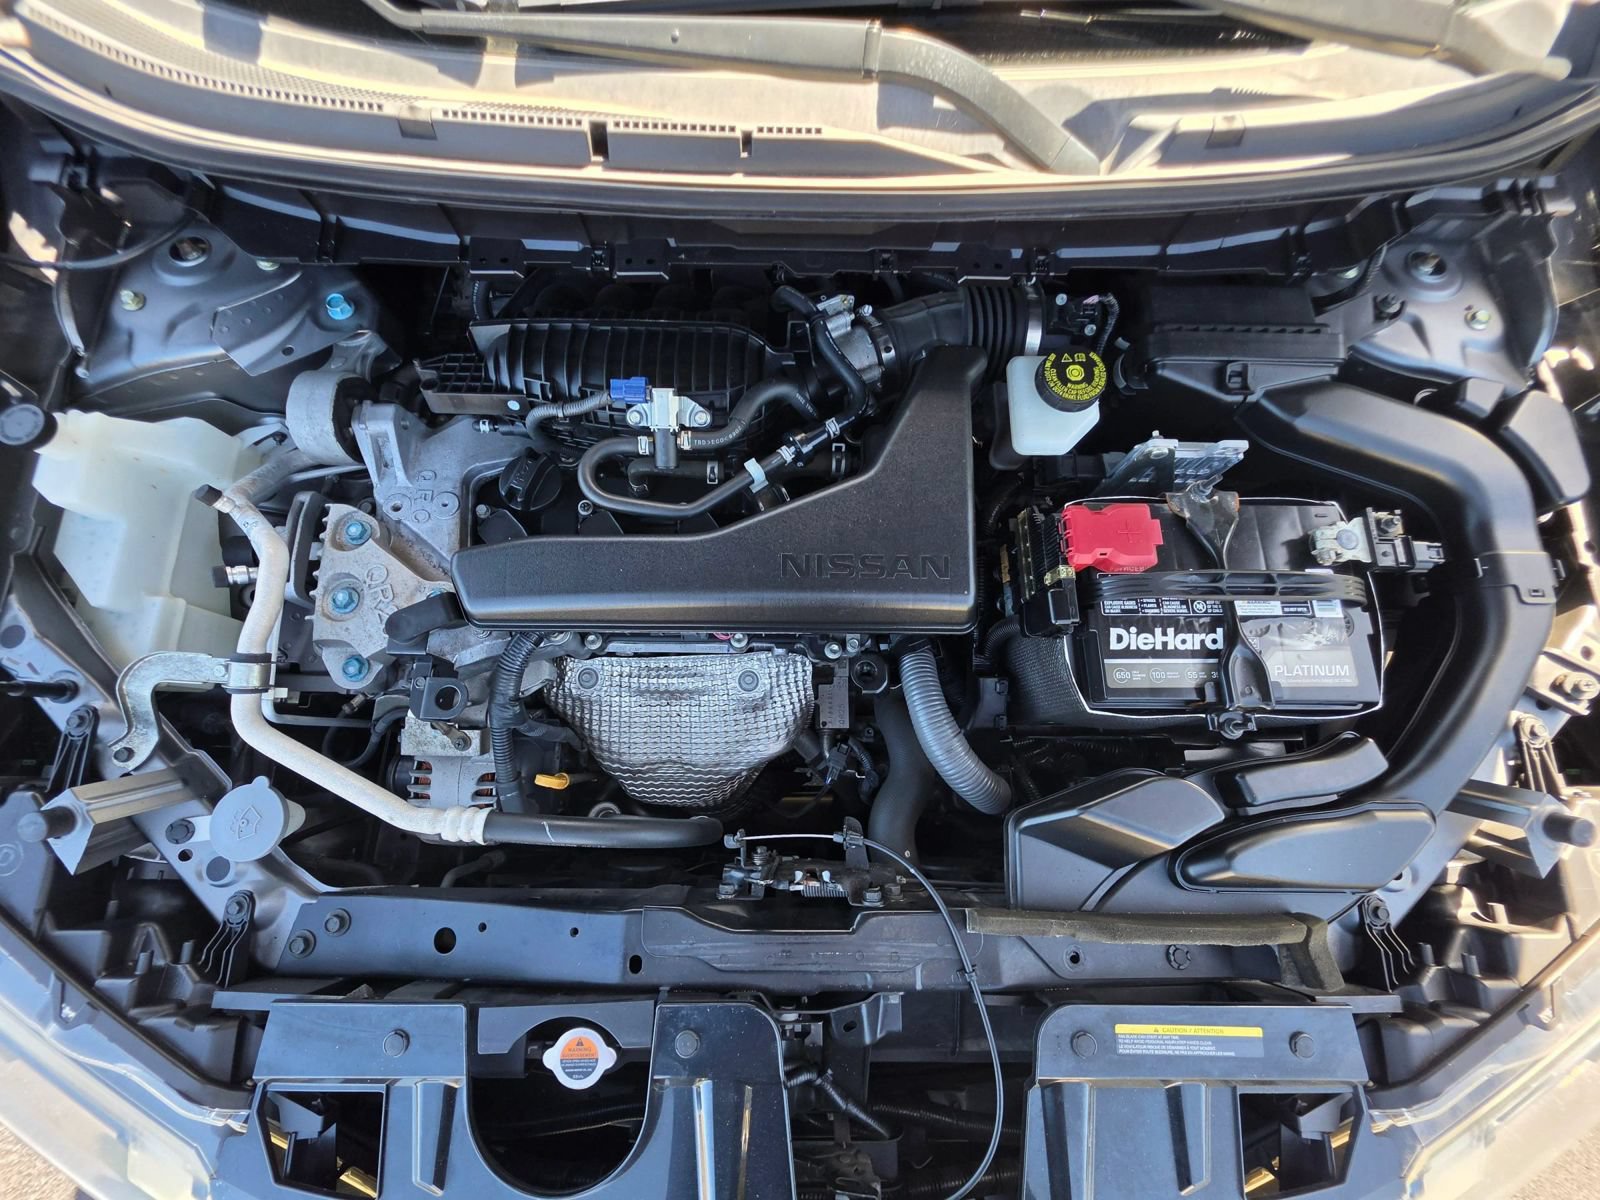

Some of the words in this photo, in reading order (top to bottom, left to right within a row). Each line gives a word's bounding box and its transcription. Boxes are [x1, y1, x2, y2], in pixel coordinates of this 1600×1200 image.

[780, 552, 951, 580] NISSAN
[1110, 626, 1224, 650] DieHard
[1116, 671, 1130, 679] 650
[1152, 671, 1166, 679] 100
[1187, 671, 1198, 679] 55
[1274, 664, 1350, 676] PLATINUM
